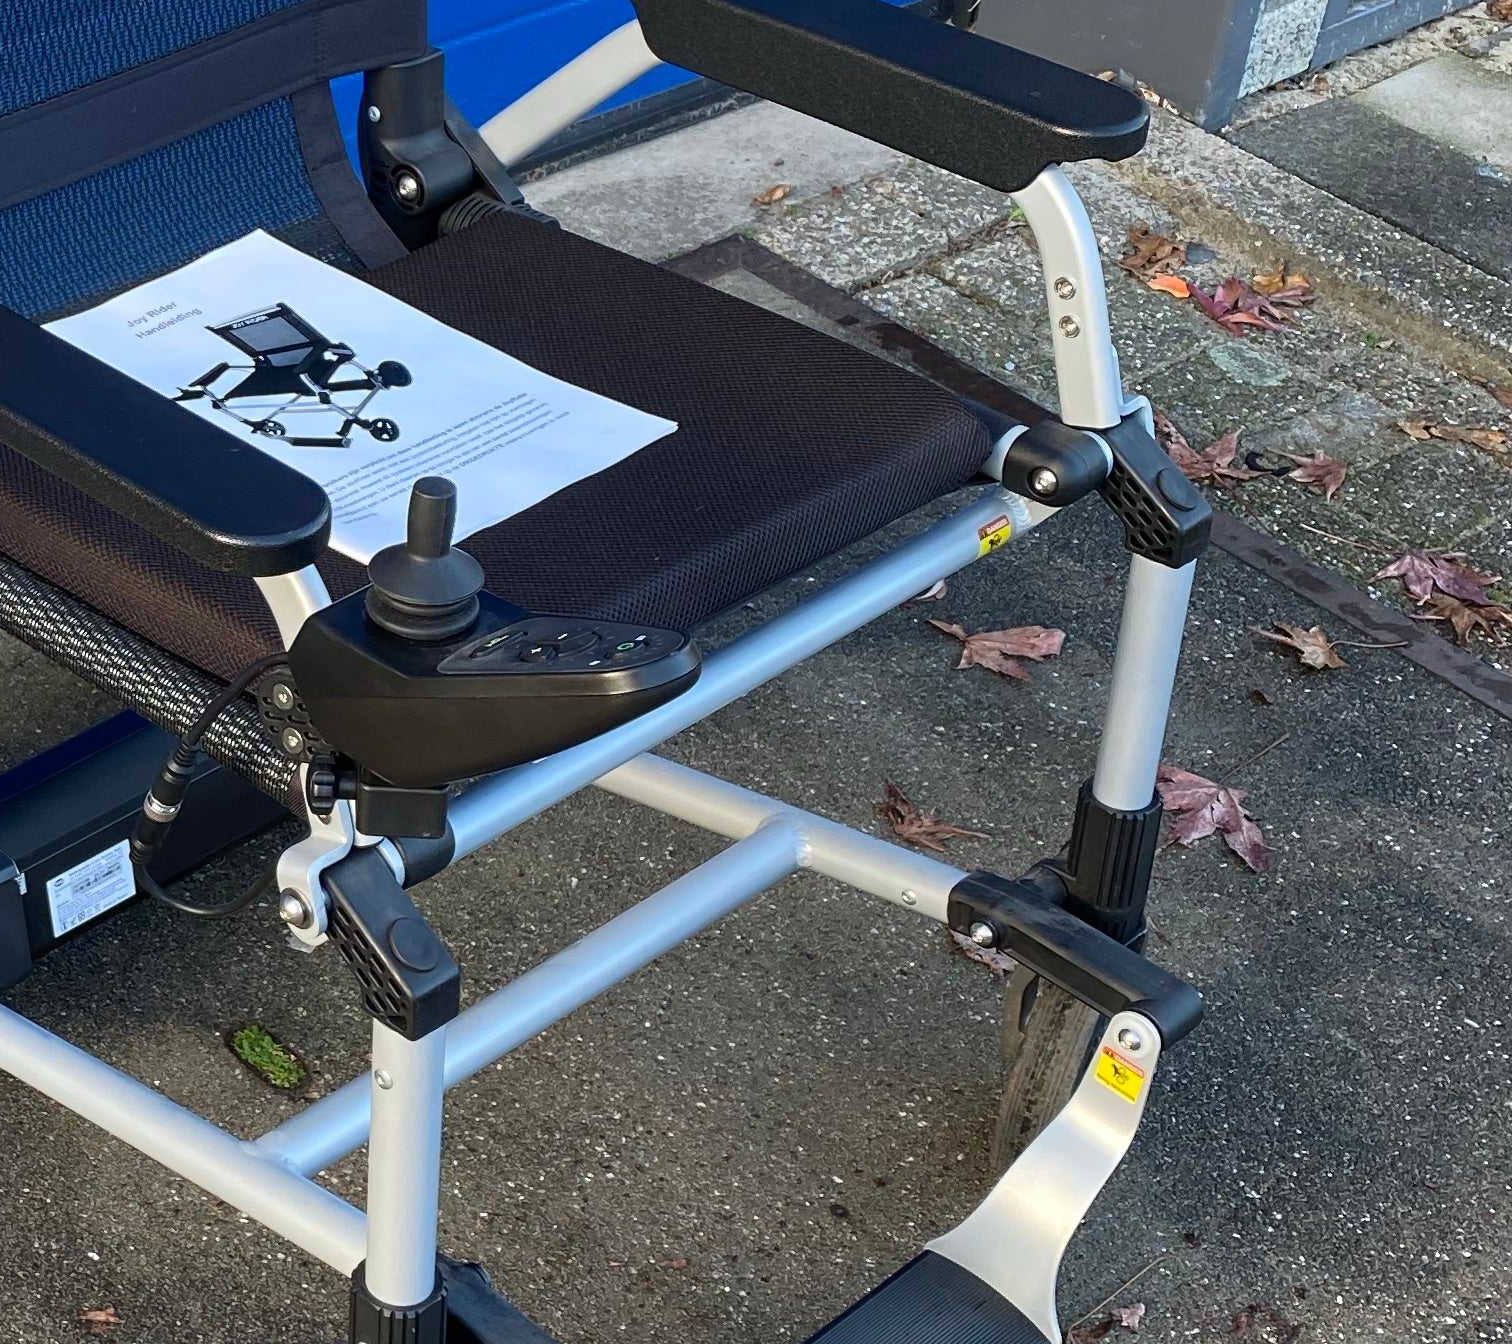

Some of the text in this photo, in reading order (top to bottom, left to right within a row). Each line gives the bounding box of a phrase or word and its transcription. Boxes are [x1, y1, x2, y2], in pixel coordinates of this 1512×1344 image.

[127, 301, 178, 328] Joy Rider
[135, 308, 203, 339] Handleiding
